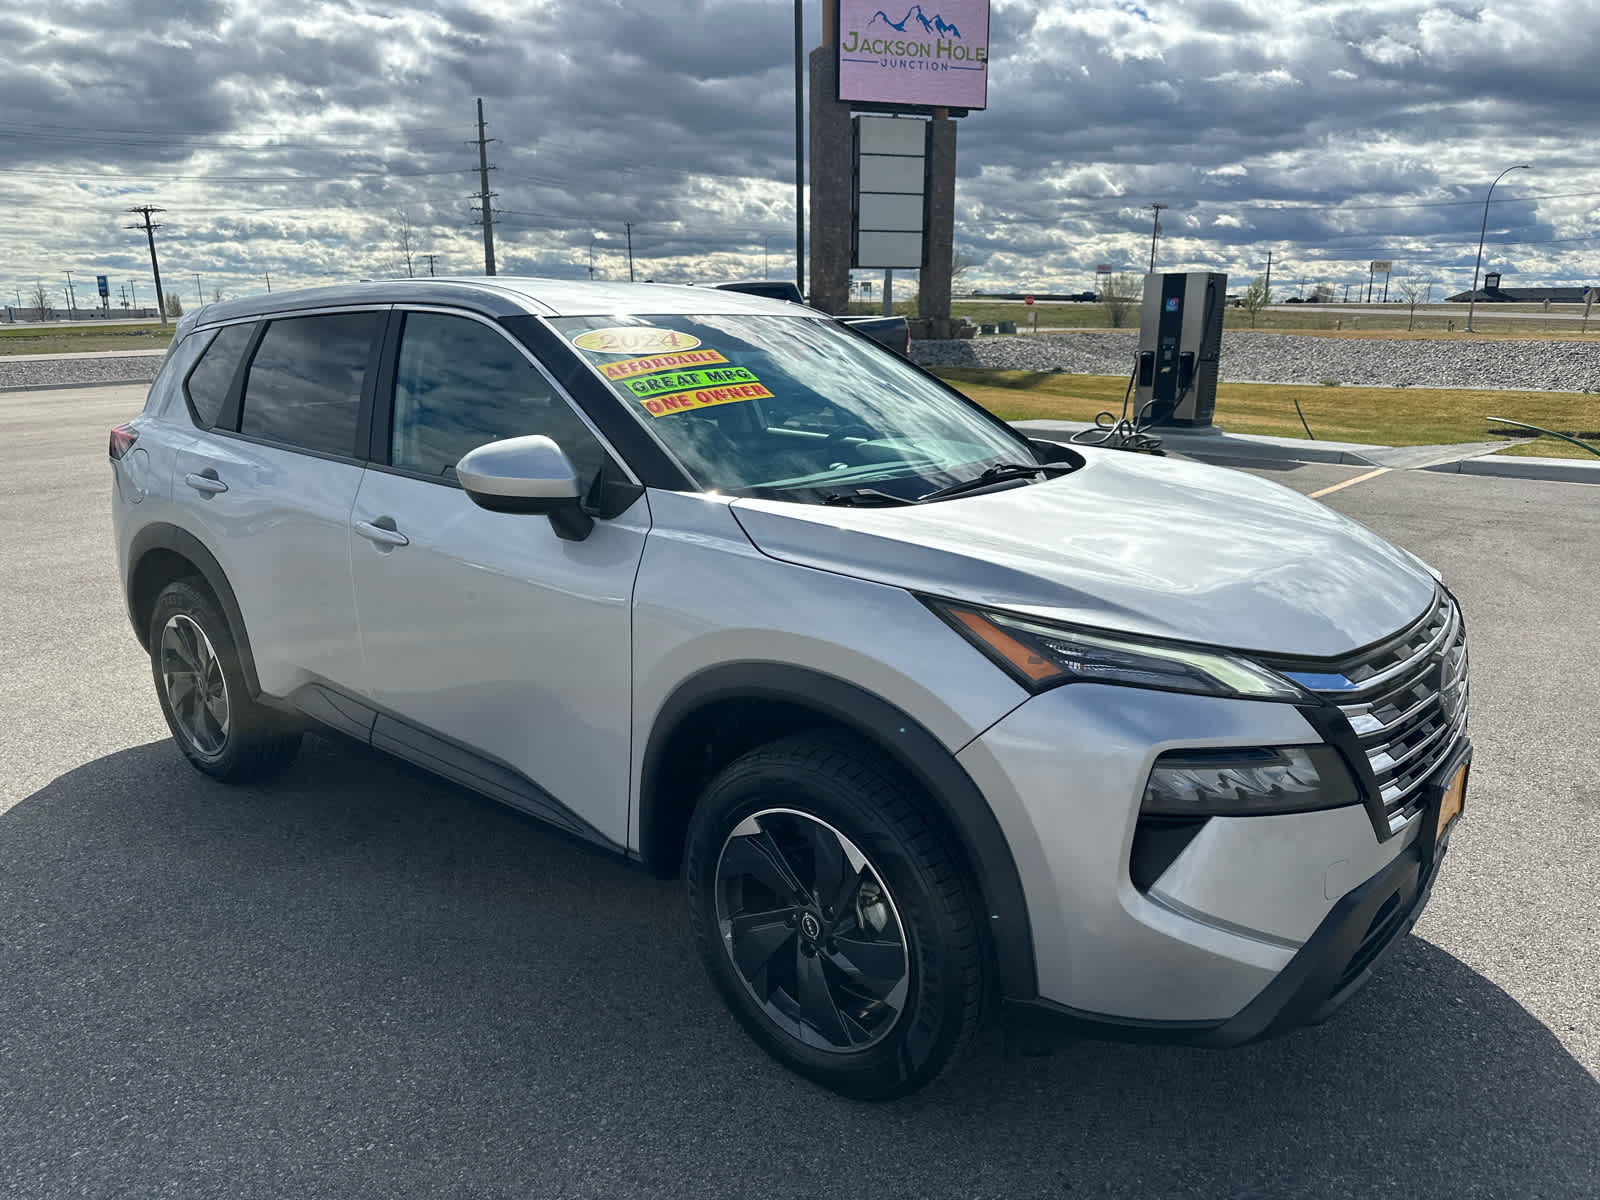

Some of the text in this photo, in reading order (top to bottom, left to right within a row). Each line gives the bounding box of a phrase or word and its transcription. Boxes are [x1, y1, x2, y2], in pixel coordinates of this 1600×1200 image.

[842, 31, 986, 62] JACKSON HOLE
[880, 59, 949, 72] JUNCTION
[599, 333, 681, 350] 2024
[606, 351, 723, 378] AFFORDABLE
[631, 369, 752, 393] GREAT MPG
[646, 384, 770, 414] ONE OWNER
